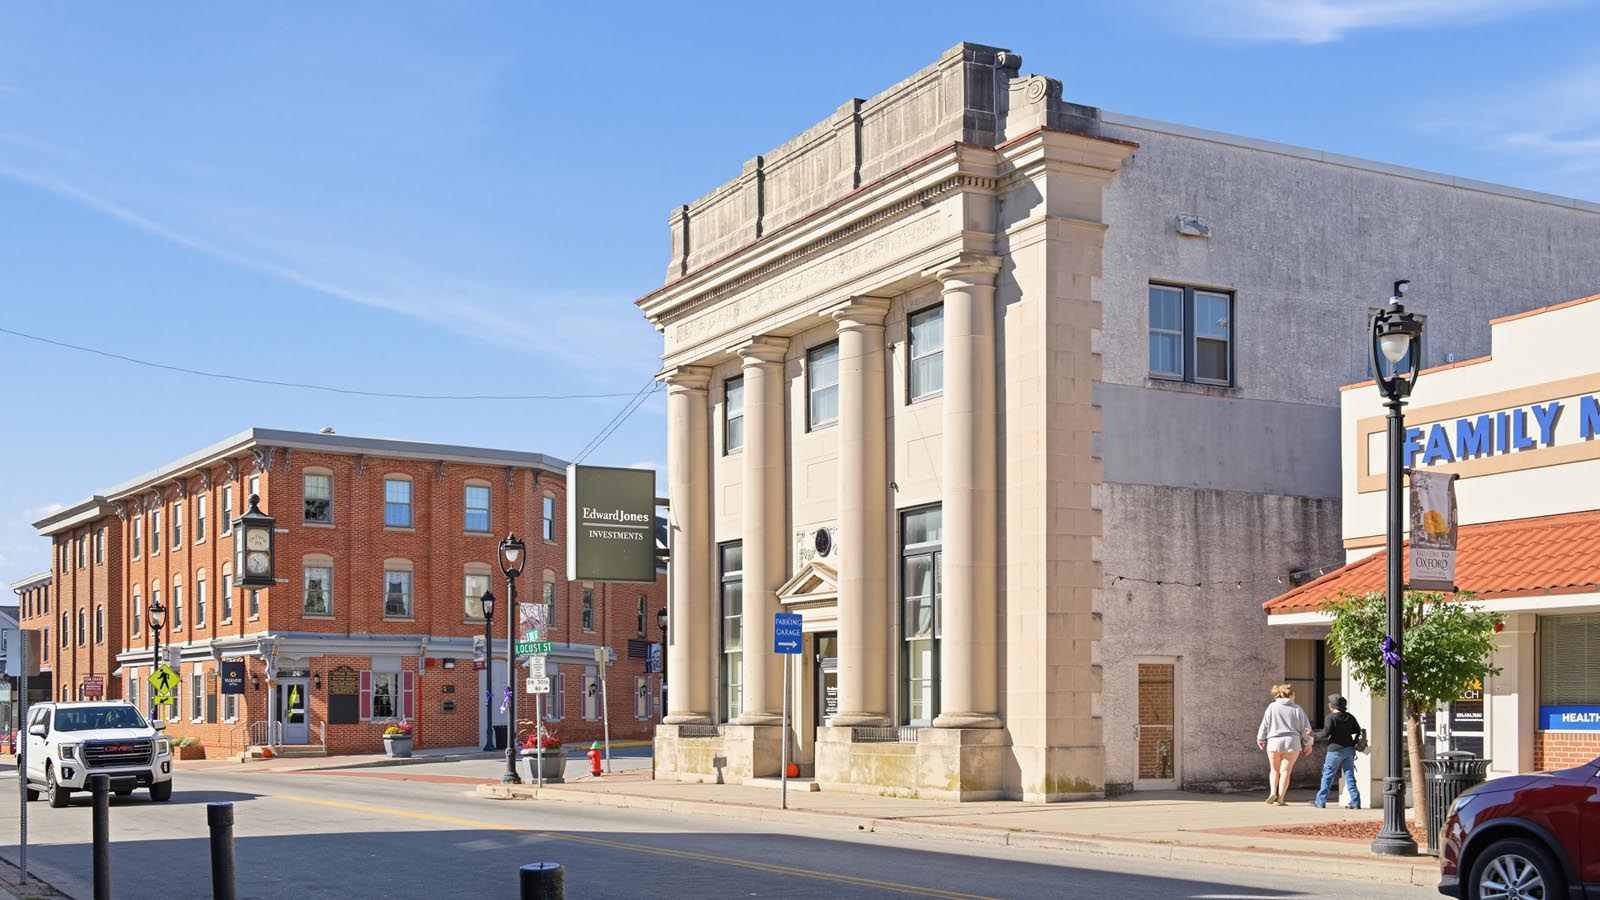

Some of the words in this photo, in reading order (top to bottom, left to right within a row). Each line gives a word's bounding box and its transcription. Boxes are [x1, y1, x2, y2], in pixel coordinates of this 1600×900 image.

[1403, 401, 1560, 468] FAMILY
[589, 530, 643, 540] INVESTMENTS
[1416, 557, 1448, 570] OXFORD
[776, 618, 802, 626] PARKING
[776, 628, 801, 636] GARAGE
[515, 644, 541, 654] LOCUST
[543, 643, 552, 652] ST
[1562, 713, 1600, 722] HEALTH
